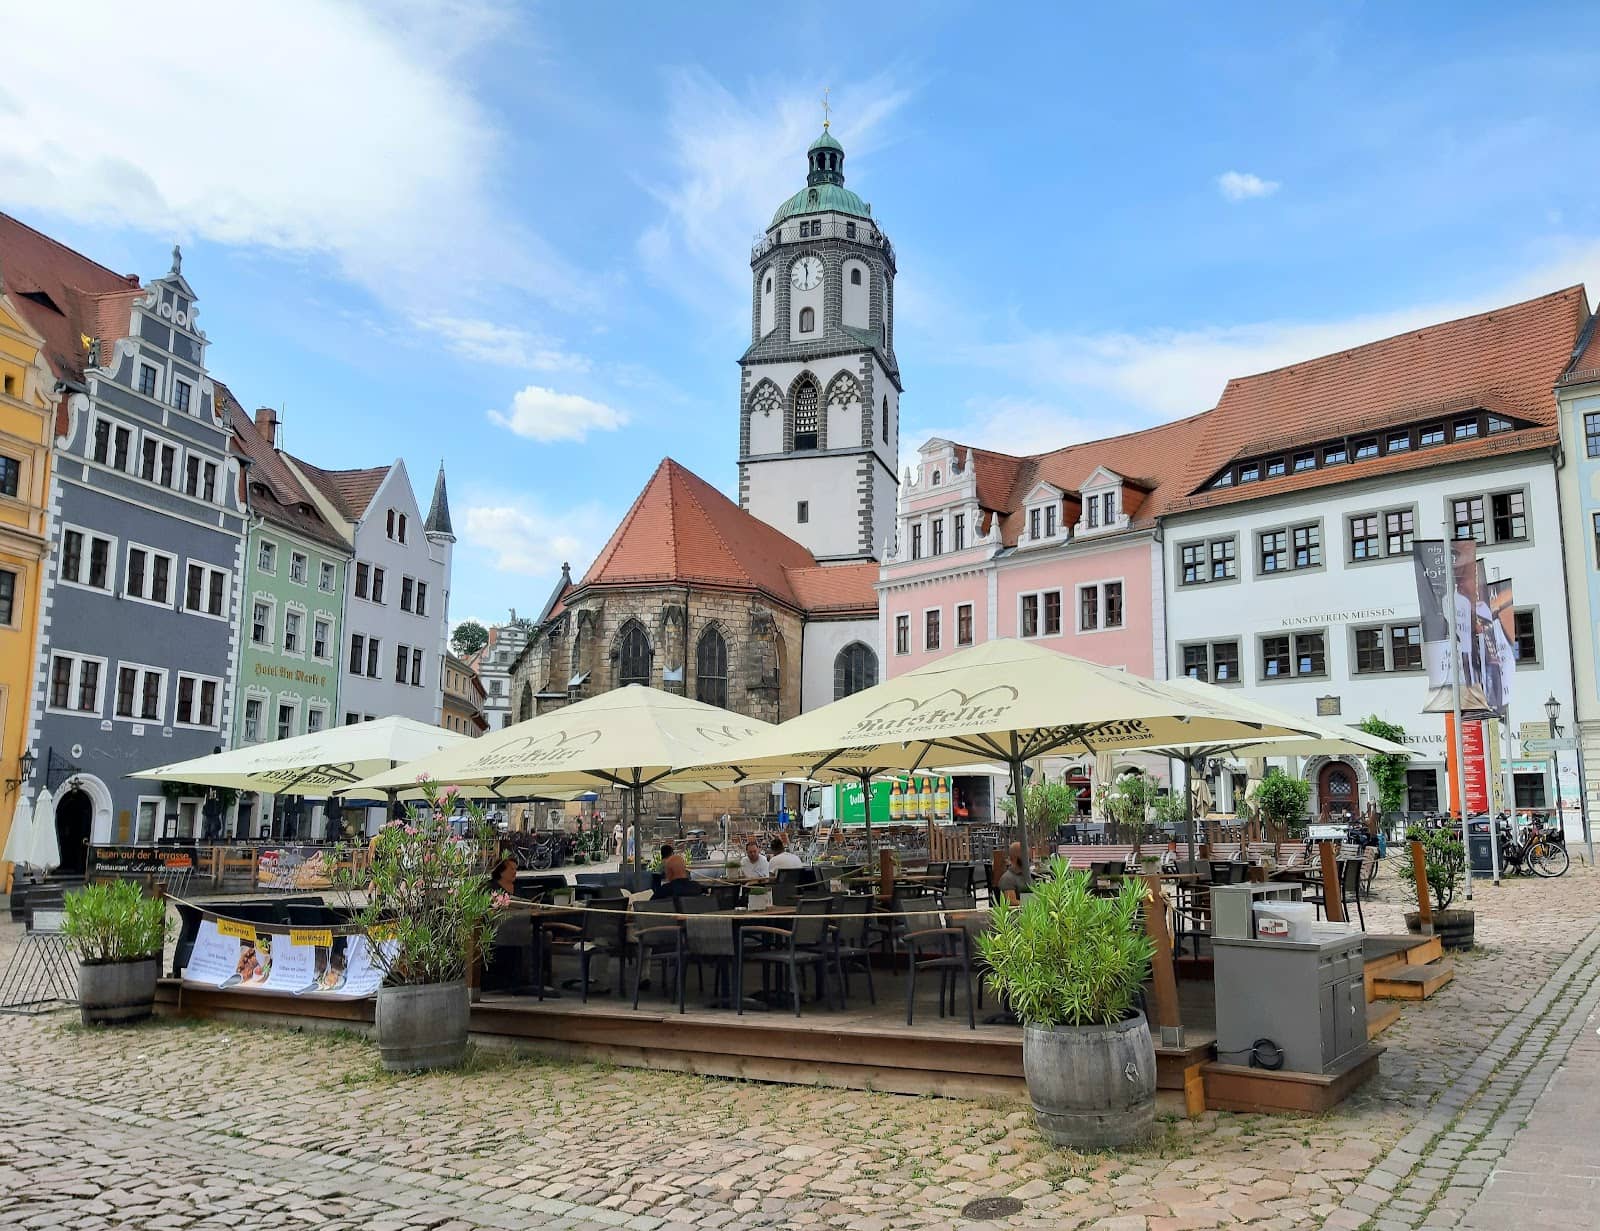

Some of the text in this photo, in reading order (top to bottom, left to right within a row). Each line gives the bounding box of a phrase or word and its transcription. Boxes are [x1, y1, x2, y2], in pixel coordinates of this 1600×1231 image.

[1281, 607, 1395, 627] KUNSTVEREIN MEISSEN
[121, 849, 137, 860] auf
[138, 850, 153, 861] der
